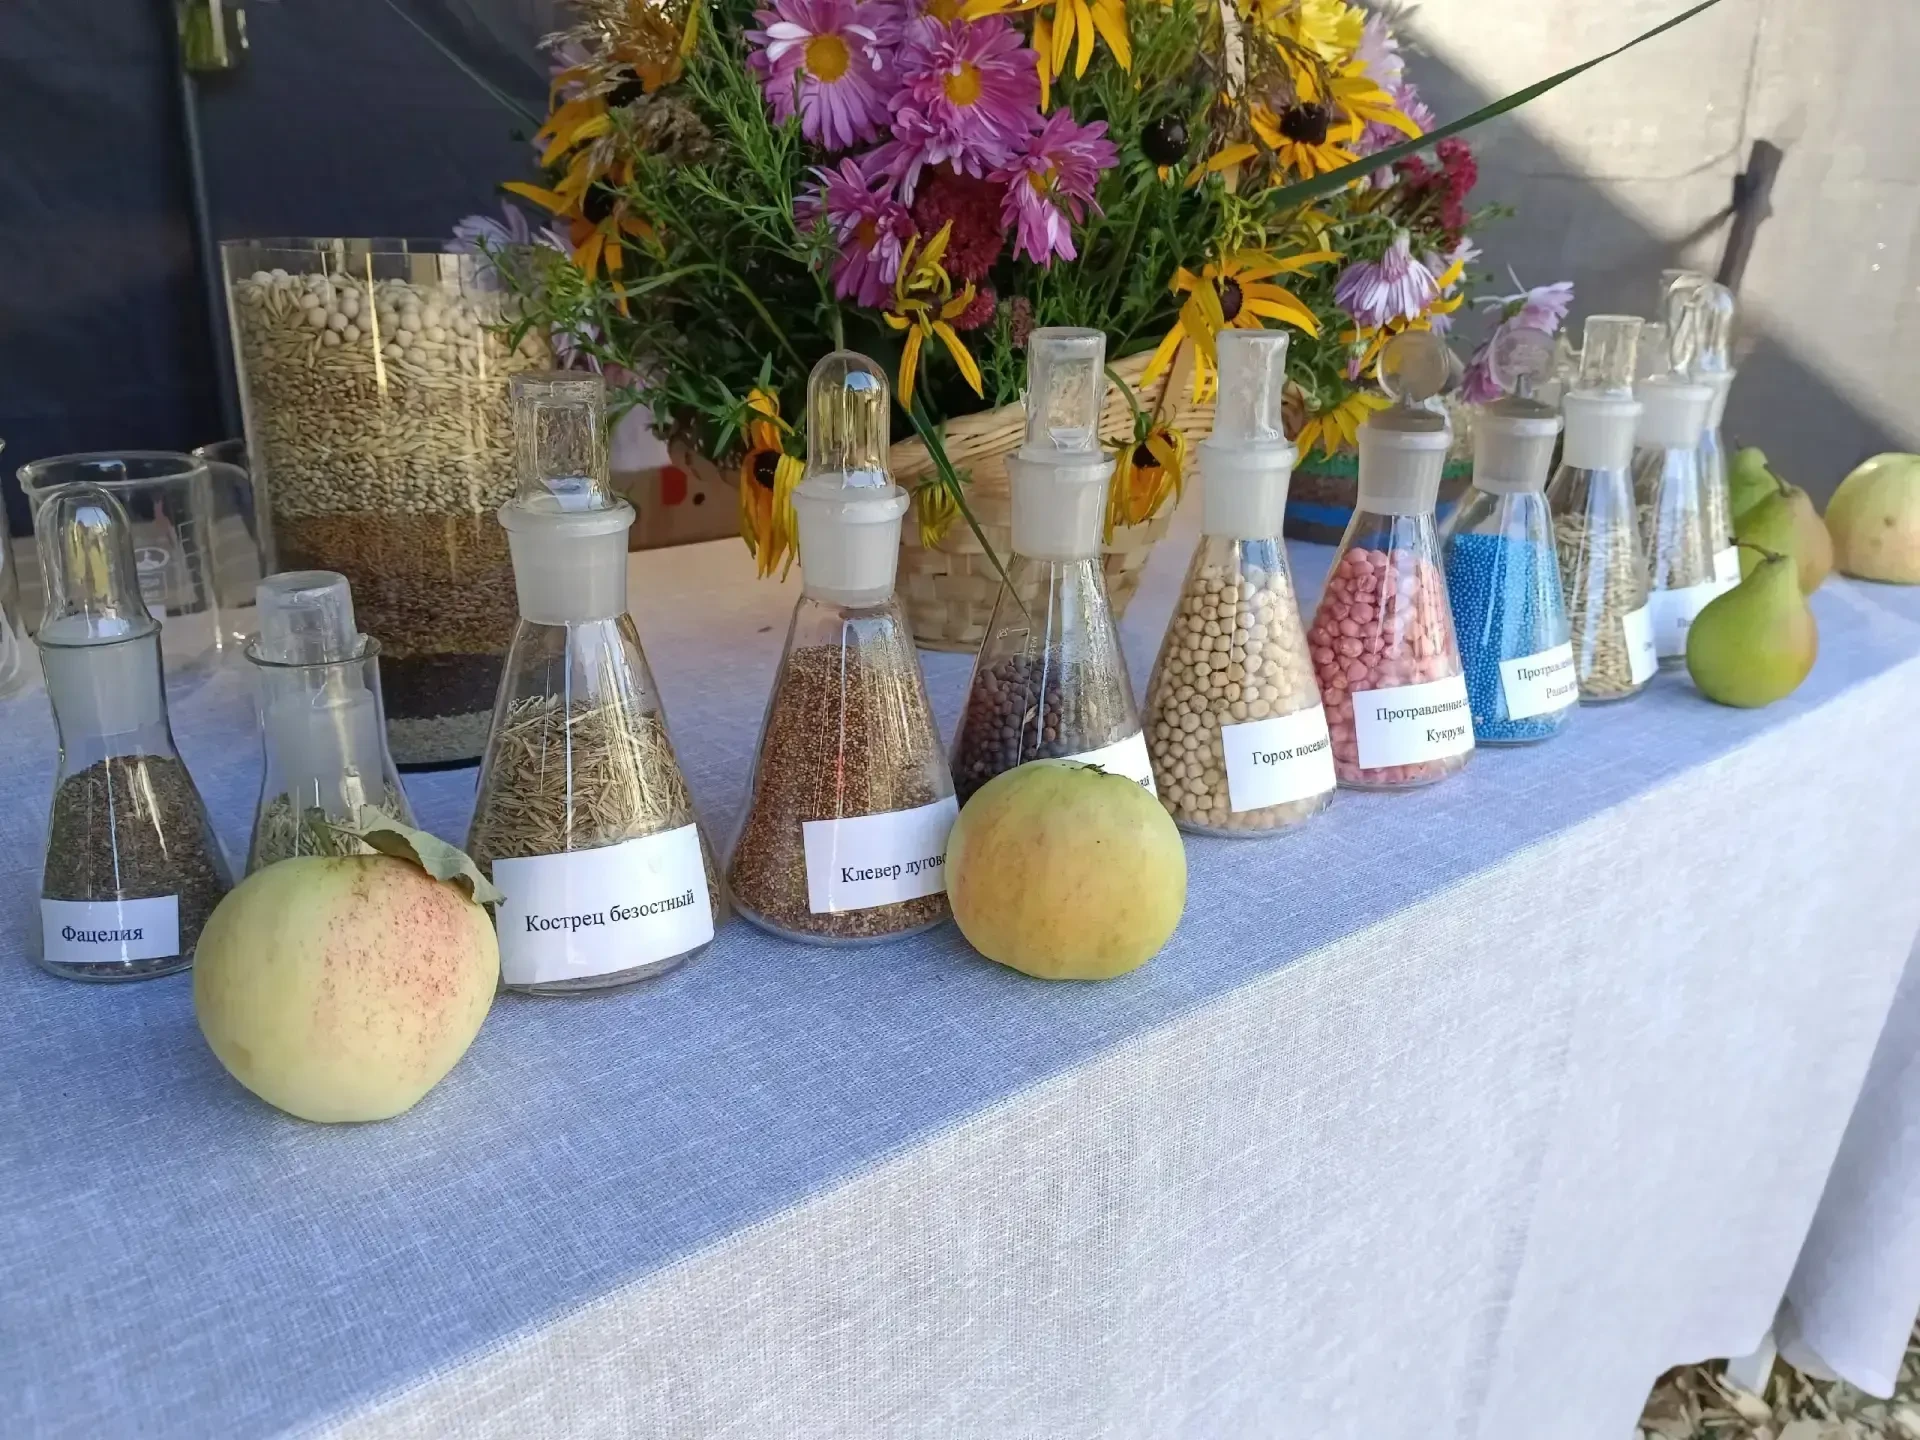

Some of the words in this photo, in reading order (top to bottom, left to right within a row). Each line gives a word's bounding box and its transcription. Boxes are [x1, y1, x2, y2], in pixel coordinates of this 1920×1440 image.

[1376, 699, 1462, 723] Протравленные
[1426, 725, 1465, 743] Кукрузы
[1252, 749, 1293, 766] Горох
[841, 864, 901, 883] Клевер
[525, 911, 606, 932] Кострец
[610, 888, 696, 922] безостный
[61, 925, 144, 945] Фацелия
